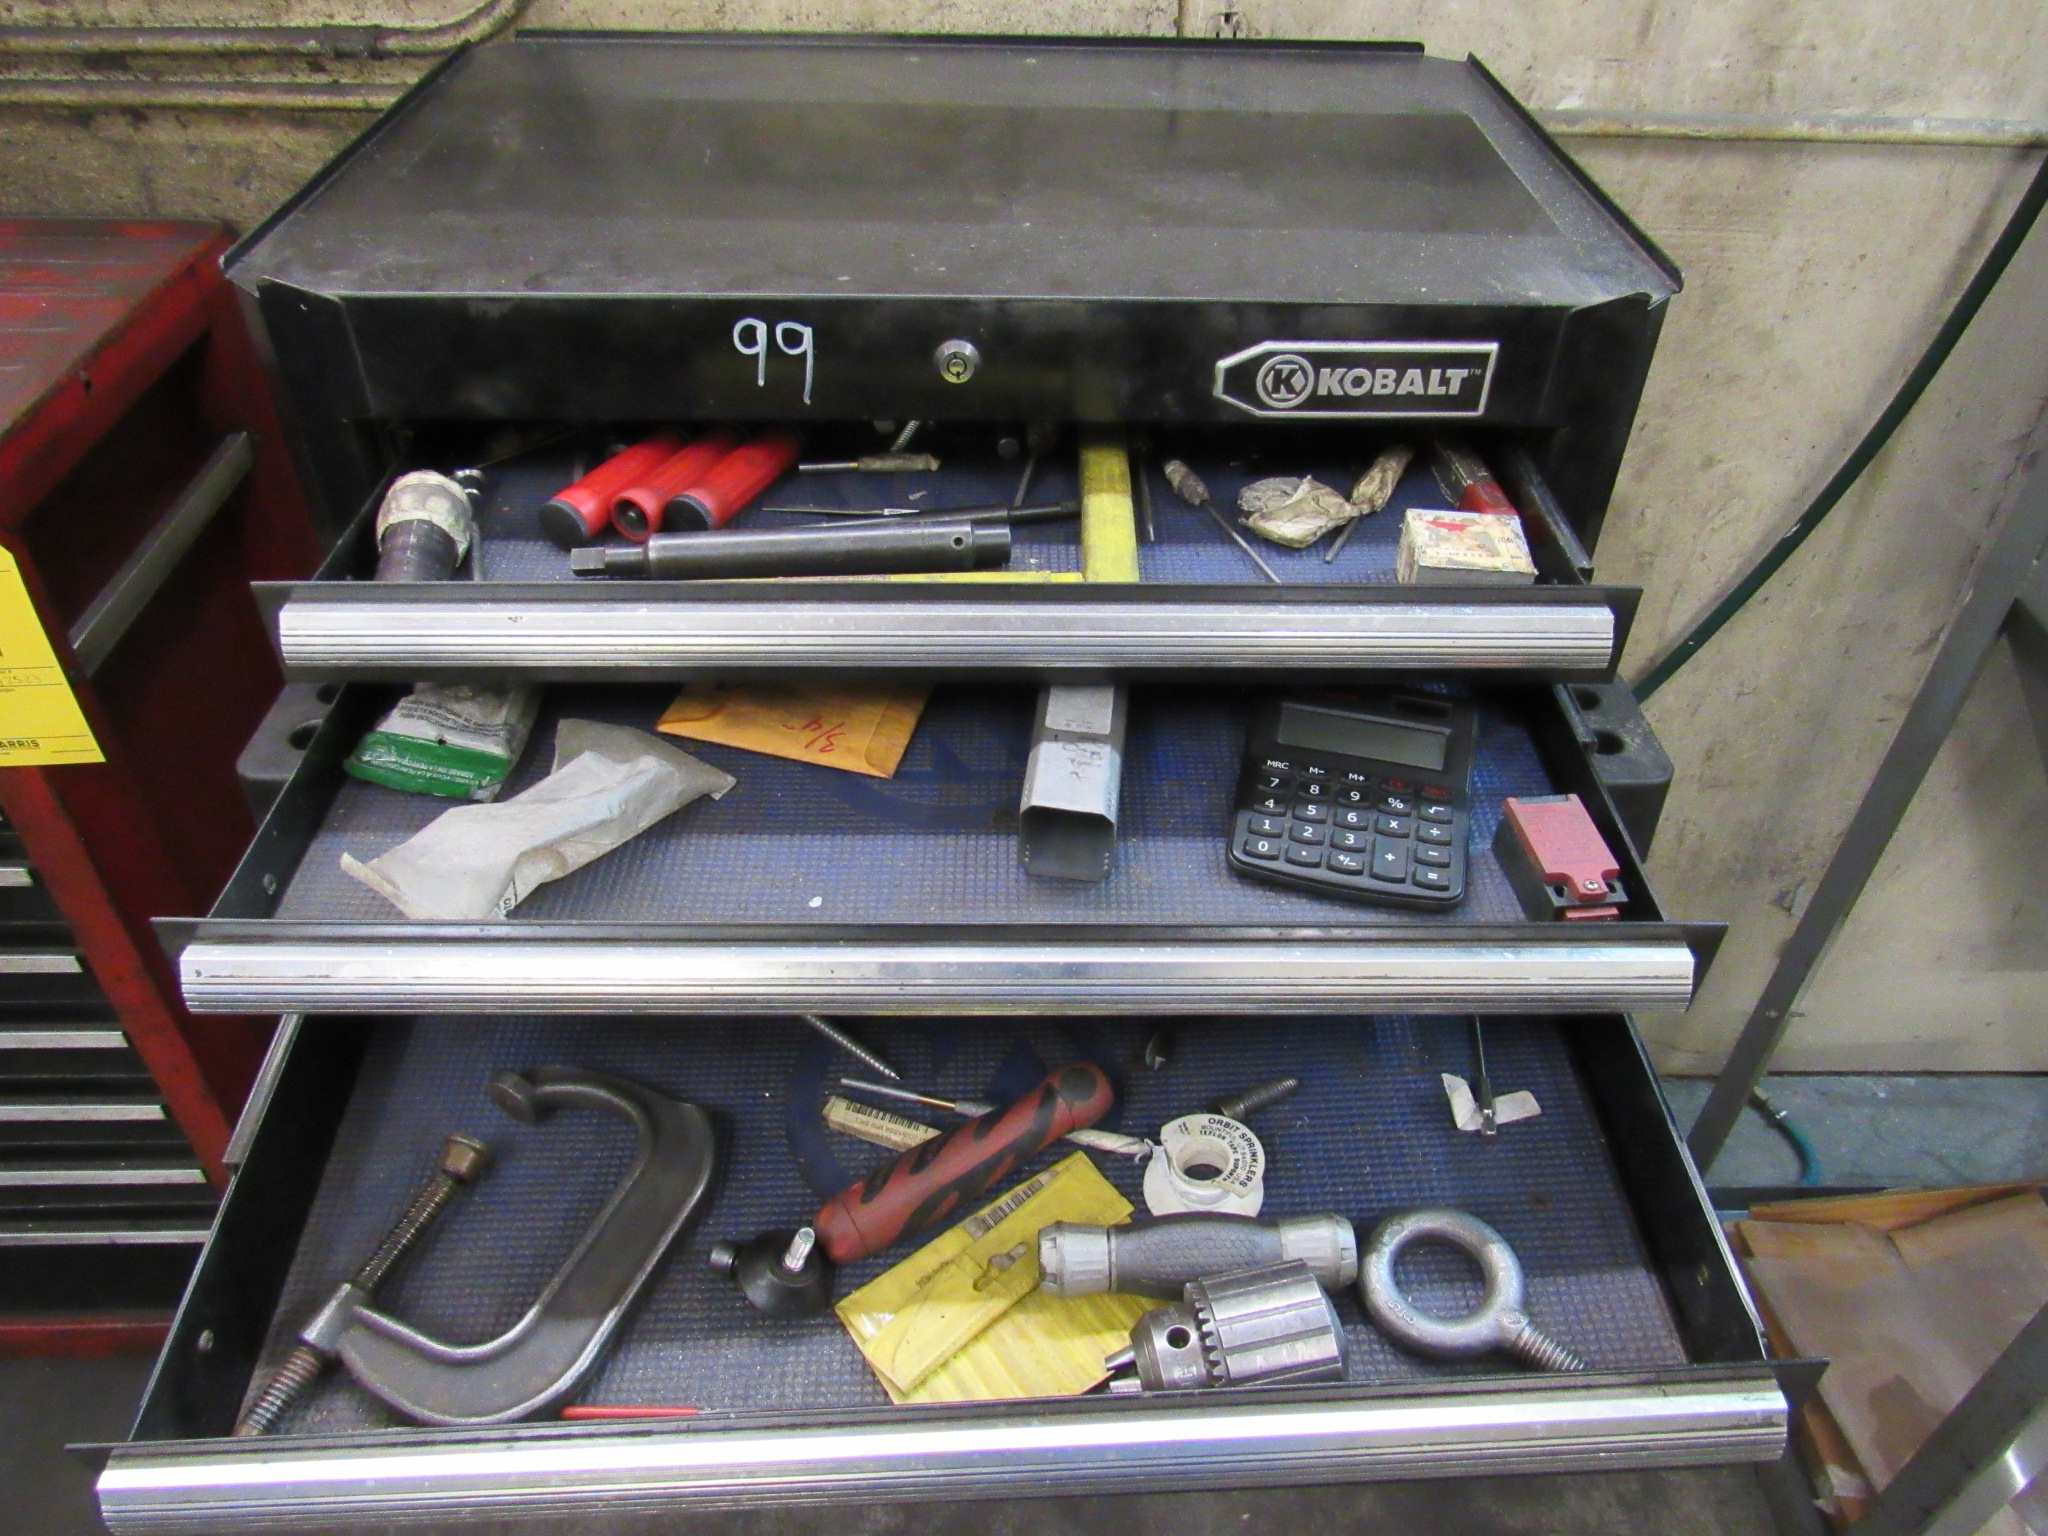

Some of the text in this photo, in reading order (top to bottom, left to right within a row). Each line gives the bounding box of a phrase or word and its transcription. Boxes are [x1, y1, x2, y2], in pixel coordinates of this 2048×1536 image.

[733, 317, 814, 405] 99
[1316, 367, 1469, 397] KOBALT
[1266, 759, 1290, 770] MRC
[1348, 773, 1366, 782] M+
[1270, 777, 1280, 788] 7
[1309, 784, 1320, 795] 8
[1350, 791, 1360, 801] 9
[1265, 799, 1275, 809] 4
[1306, 805, 1317, 815] 5
[1347, 812, 1358, 823] 6
[1262, 819, 1271, 830] 1
[1303, 827, 1313, 837] 2
[1344, 833, 1355, 844] 3
[1258, 841, 1268, 852] 0
[1208, 1117, 1259, 1187] ORBIT SPRINKLERS
[1227, 1140, 1239, 1154] TAPE
